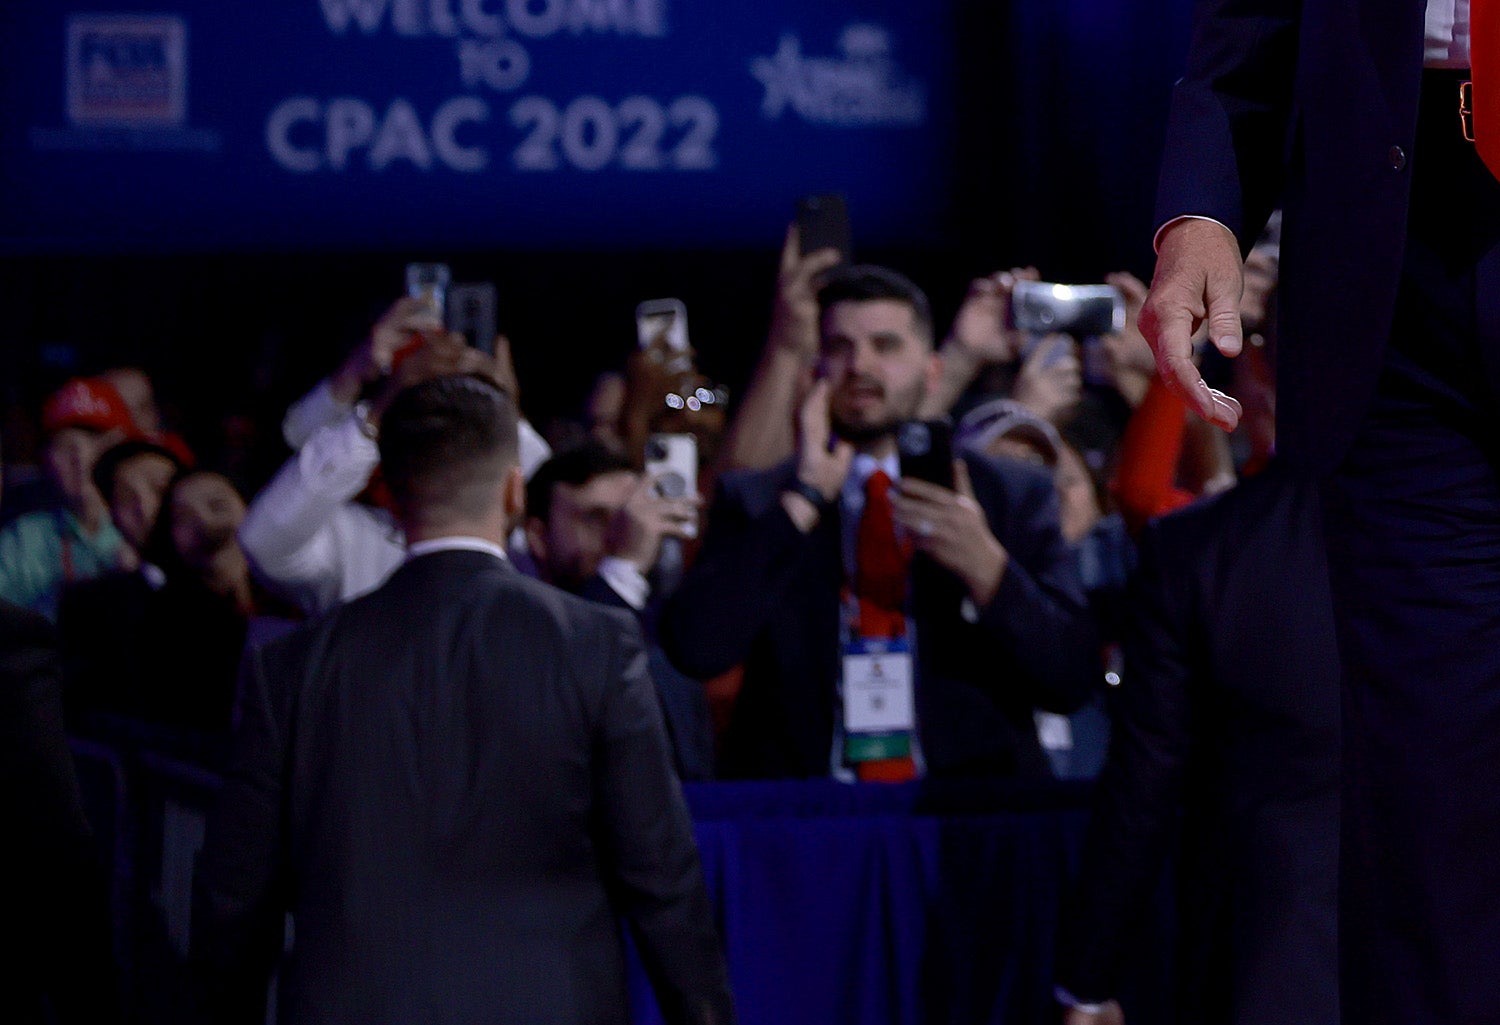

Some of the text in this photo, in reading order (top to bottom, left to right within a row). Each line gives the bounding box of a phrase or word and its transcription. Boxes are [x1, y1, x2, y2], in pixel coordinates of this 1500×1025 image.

[458, 38, 530, 90] TO
[265, 94, 720, 173] CPAC 2022
